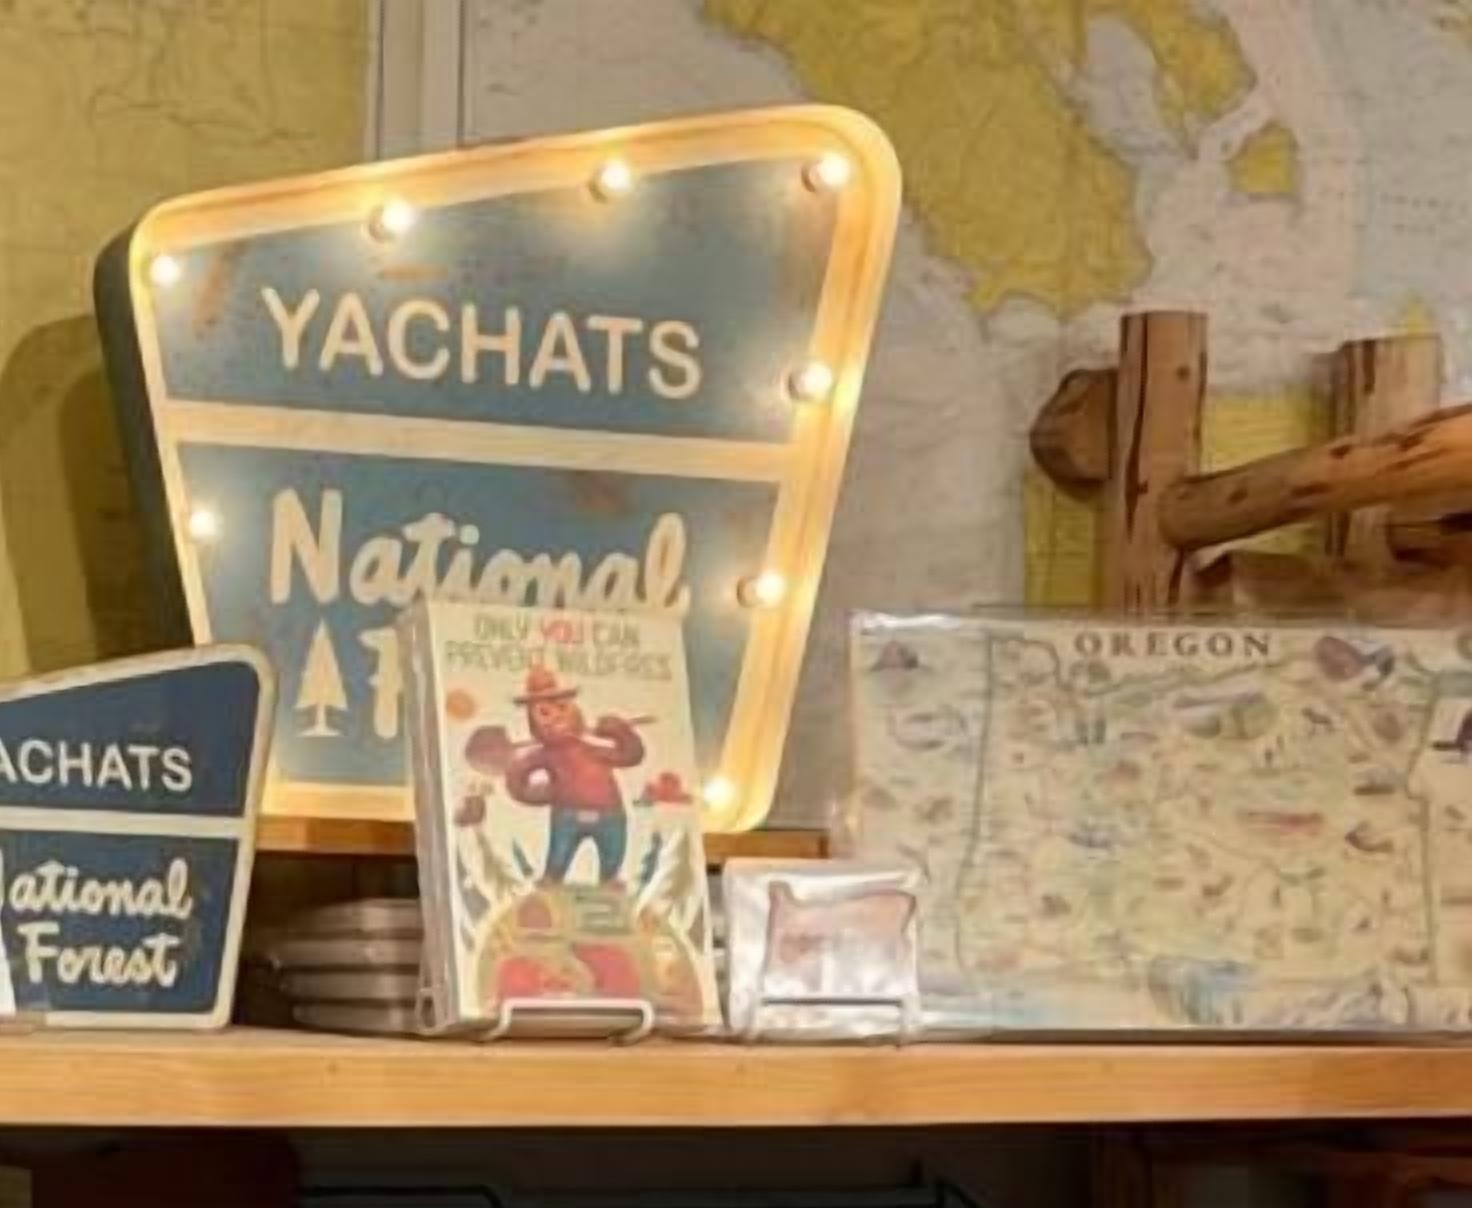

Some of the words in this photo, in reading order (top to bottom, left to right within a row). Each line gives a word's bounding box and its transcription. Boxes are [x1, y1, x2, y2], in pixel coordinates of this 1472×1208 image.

[260, 287, 702, 400] YACHATS
[270, 488, 691, 612] National
[539, 616, 583, 645] YOU
[591, 619, 640, 648] CAN
[1075, 632, 1271, 657] OREGON
[17, 921, 181, 988] Forest
